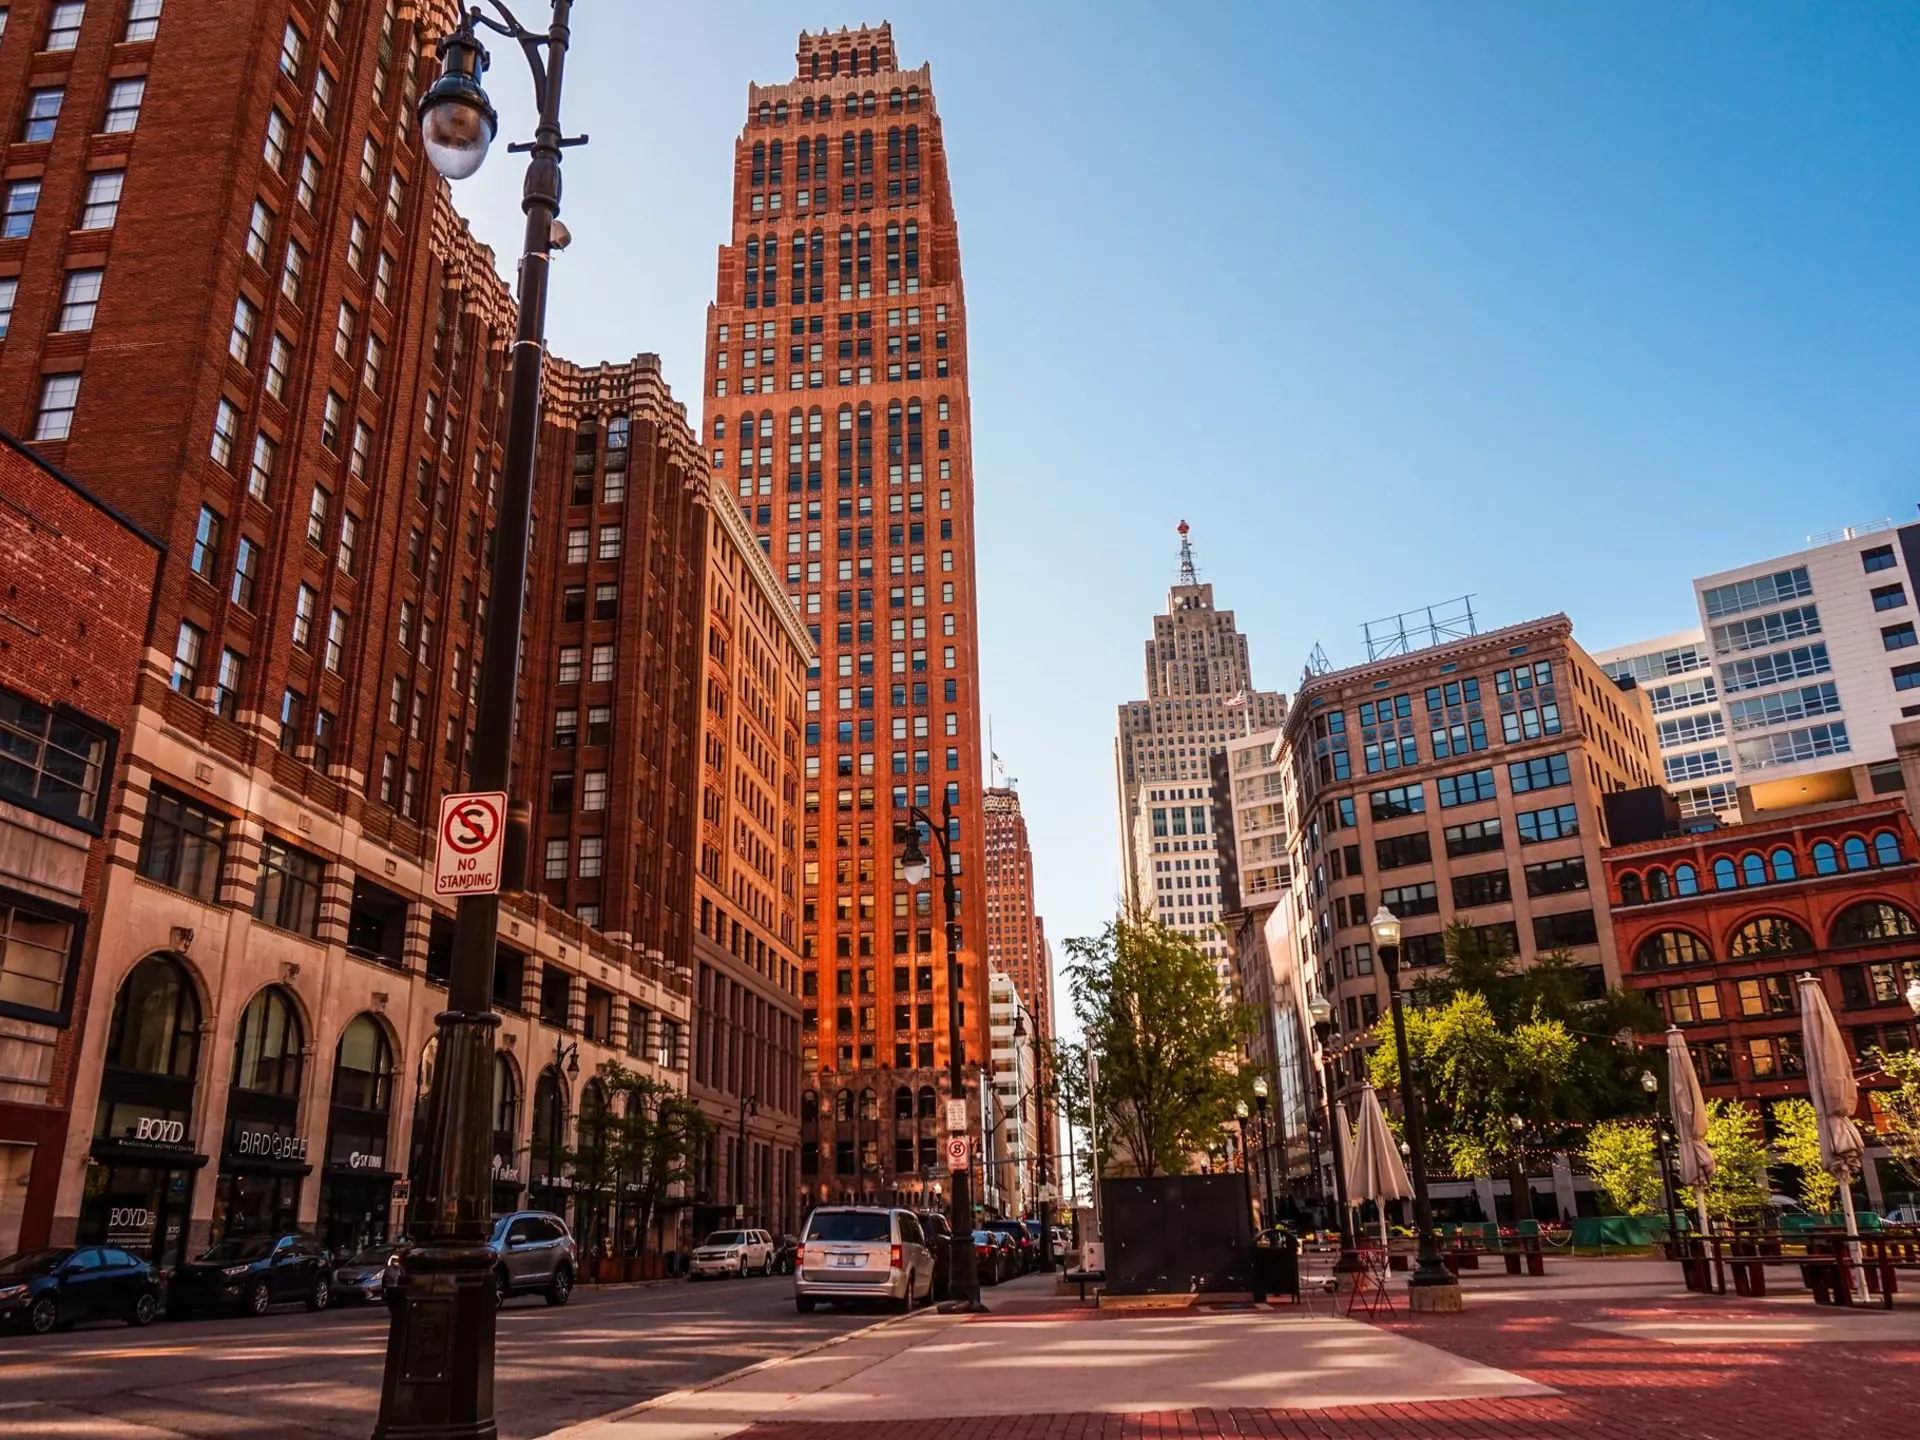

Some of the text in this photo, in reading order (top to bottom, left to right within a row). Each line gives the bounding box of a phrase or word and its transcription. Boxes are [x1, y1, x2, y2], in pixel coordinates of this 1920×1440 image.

[458, 858, 477, 871] NO
[439, 873, 493, 889] STANDING
[135, 1117, 184, 1143] BOYD
[239, 1131, 271, 1155] BIRD
[282, 1137, 308, 1160] BEE
[109, 1207, 148, 1226] BOYD
[167, 1226, 181, 1234] BOYD
